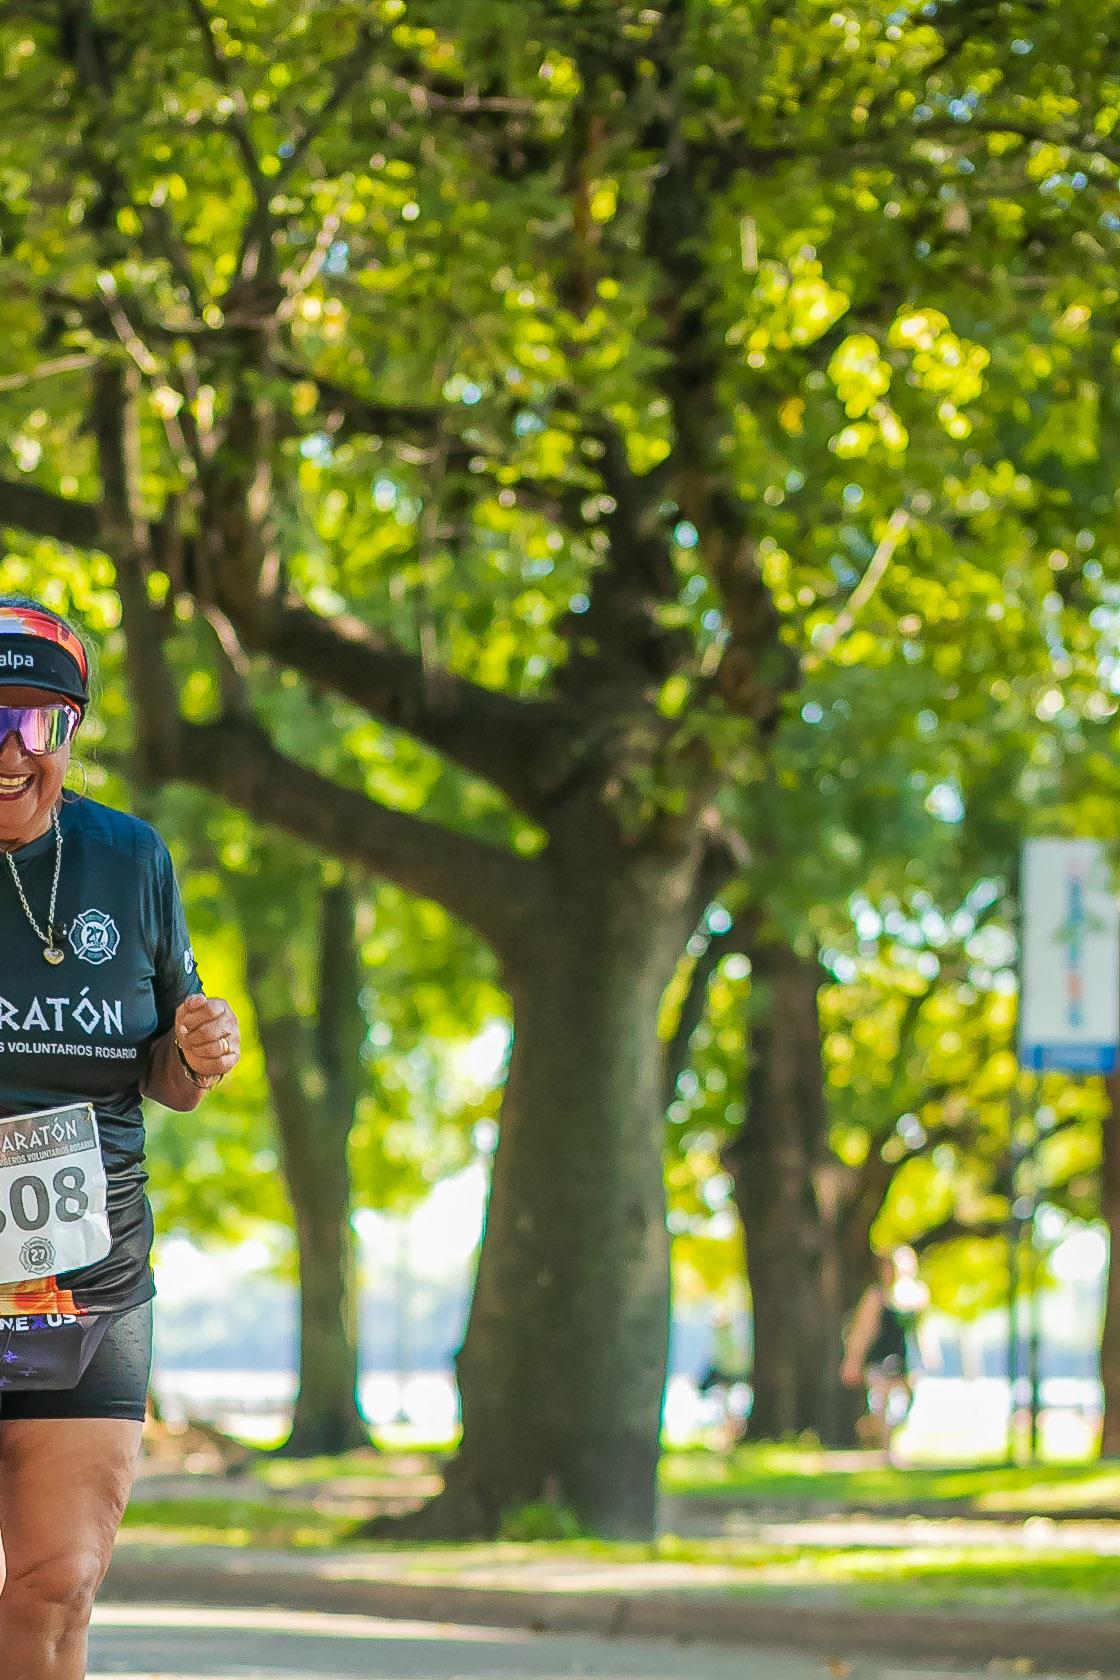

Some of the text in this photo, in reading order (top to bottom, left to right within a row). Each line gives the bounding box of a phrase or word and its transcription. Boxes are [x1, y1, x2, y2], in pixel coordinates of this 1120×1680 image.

[7, 1042, 93, 1057] VOLUNTARIOS
[95, 1046, 137, 1059] ROSARIO
[26, 1145, 69, 1162] VOLUNTARIOS
[30, 1248, 46, 1262] 27
